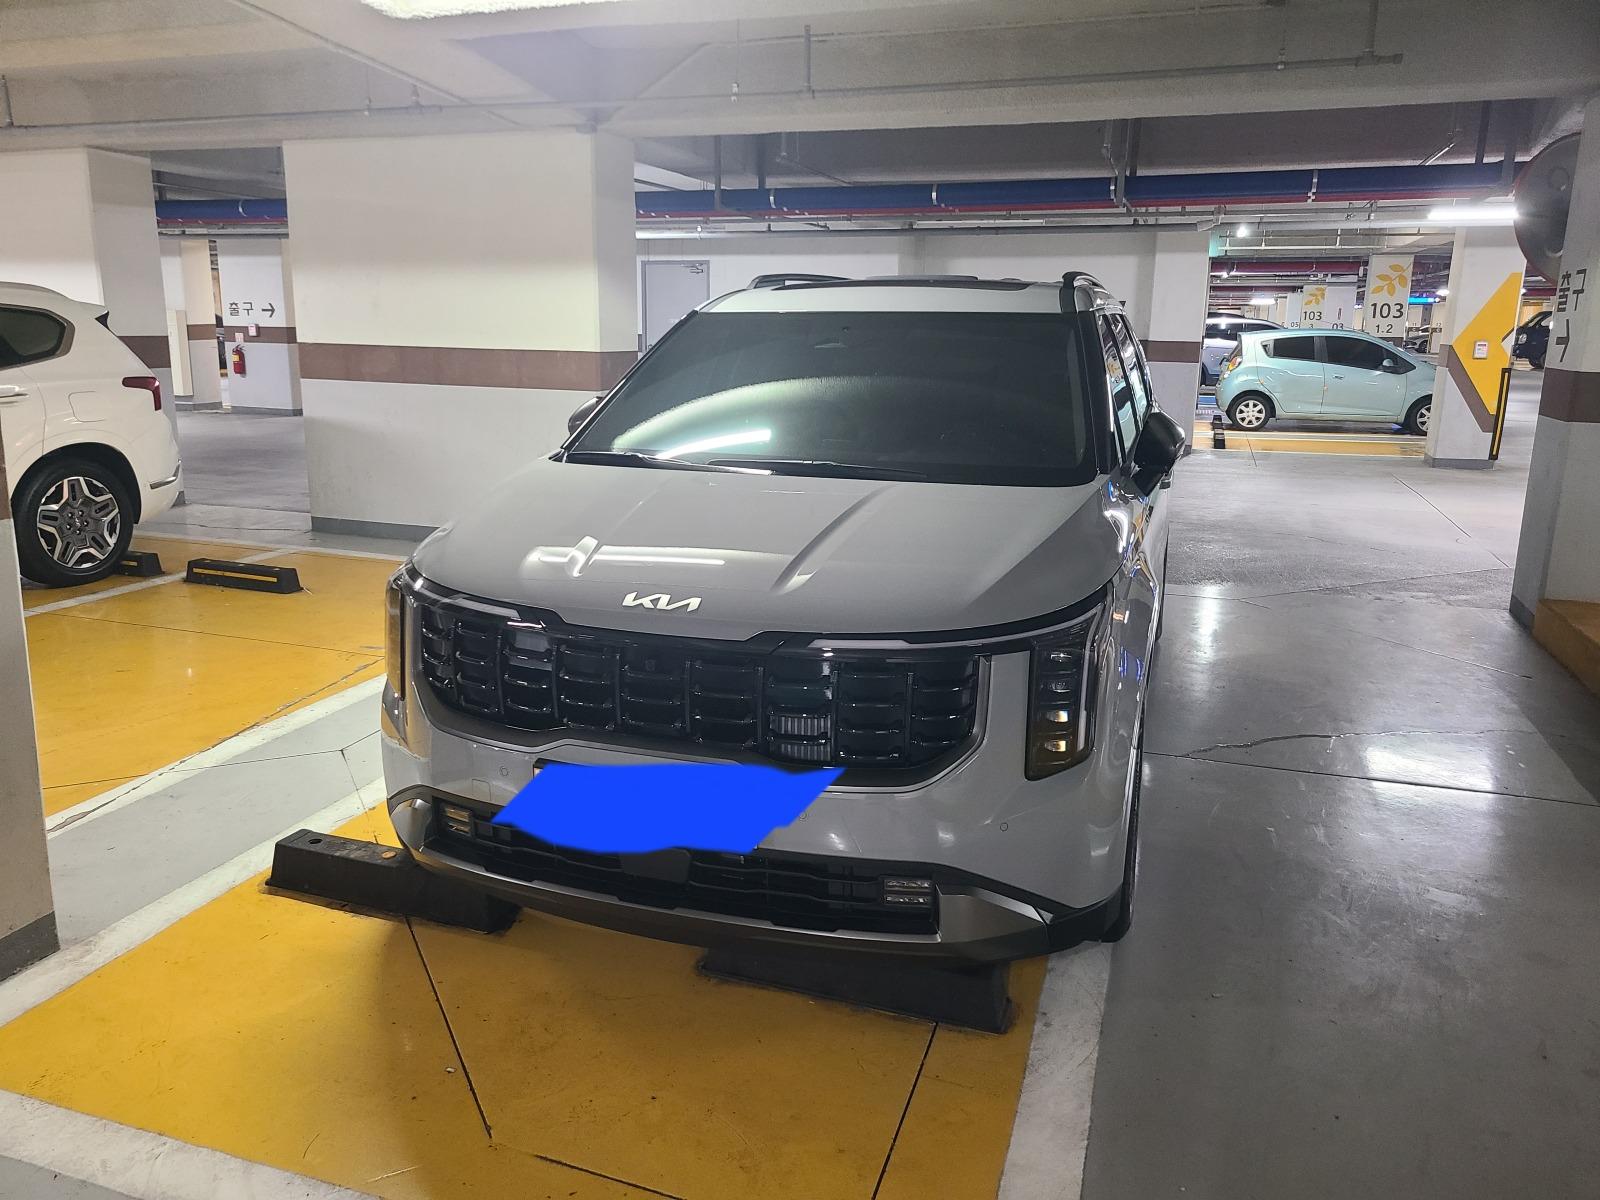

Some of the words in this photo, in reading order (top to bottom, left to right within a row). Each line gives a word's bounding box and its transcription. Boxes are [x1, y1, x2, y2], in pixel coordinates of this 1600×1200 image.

[1556, 268, 1587, 313] 출구
[228, 301, 254, 317] 출구
[1303, 310, 1322, 321] 103
[1370, 302, 1404, 319] 103
[1375, 323, 1393, 334] 1.2
